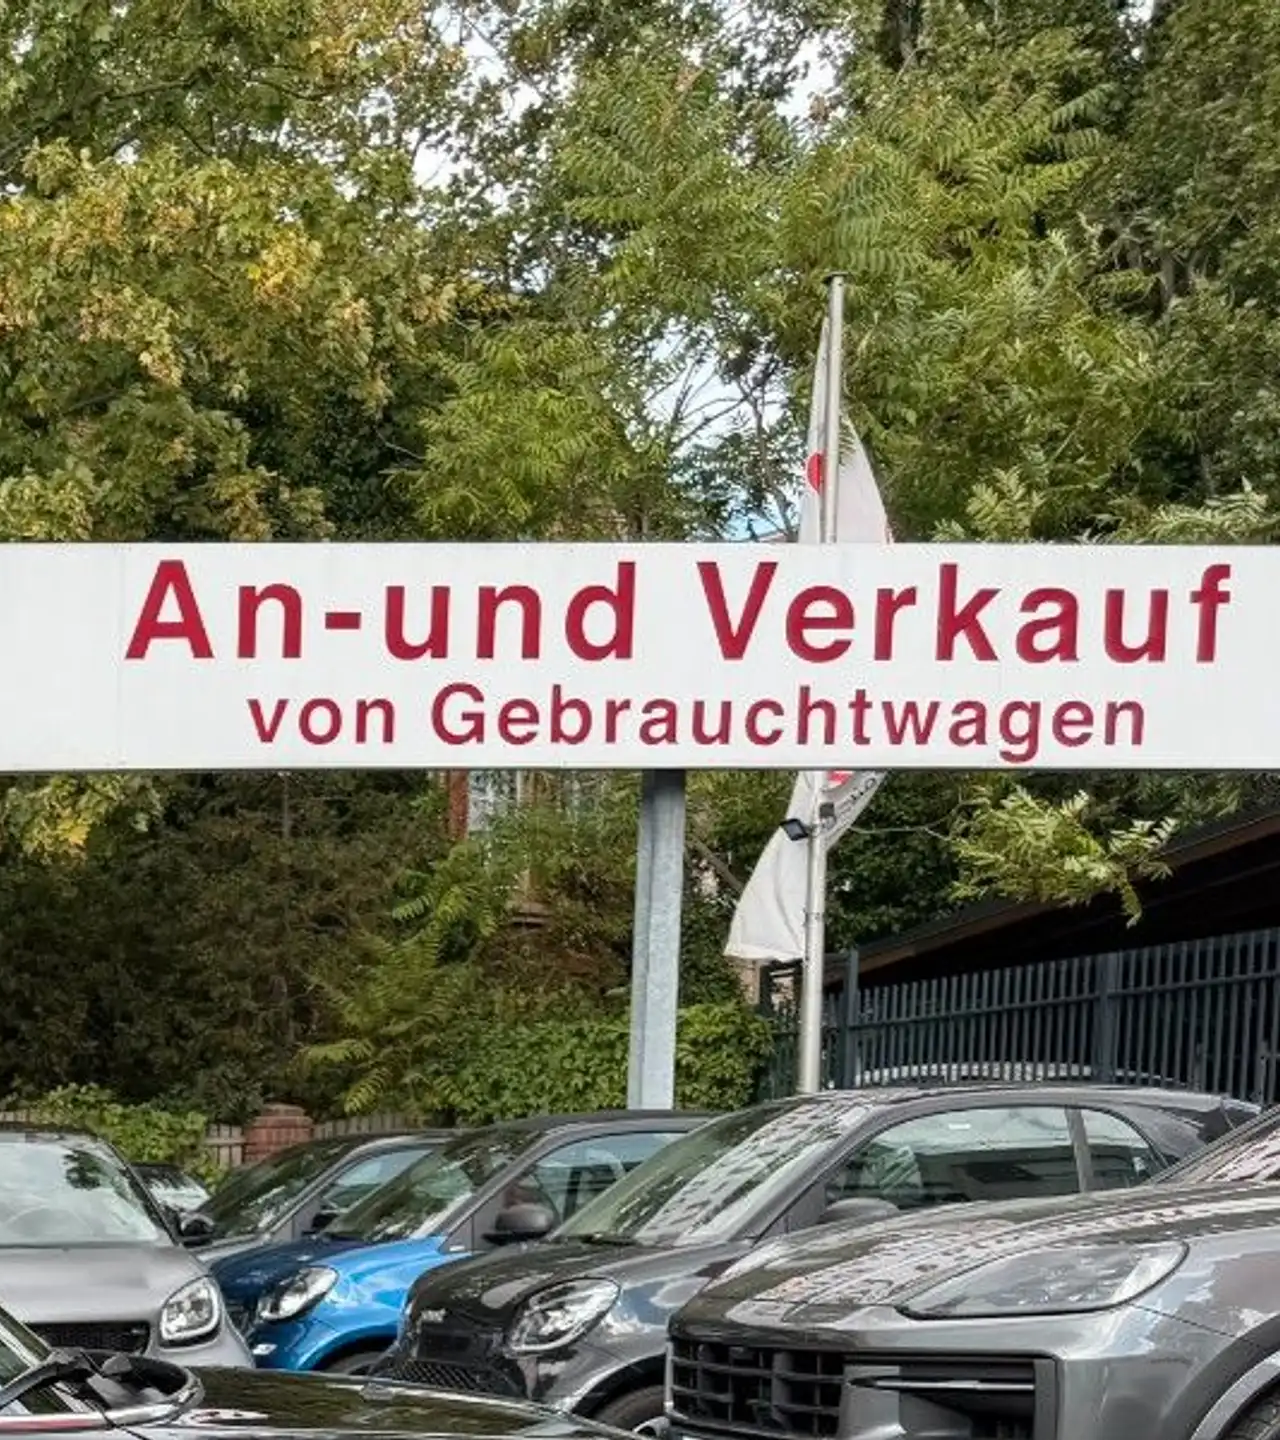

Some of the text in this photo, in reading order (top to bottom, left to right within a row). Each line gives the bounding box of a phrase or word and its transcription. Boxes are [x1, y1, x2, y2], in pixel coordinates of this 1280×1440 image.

[125, 559, 1232, 664] An-und Verkauf
[248, 683, 1146, 763] von Gebrauchtwagen
